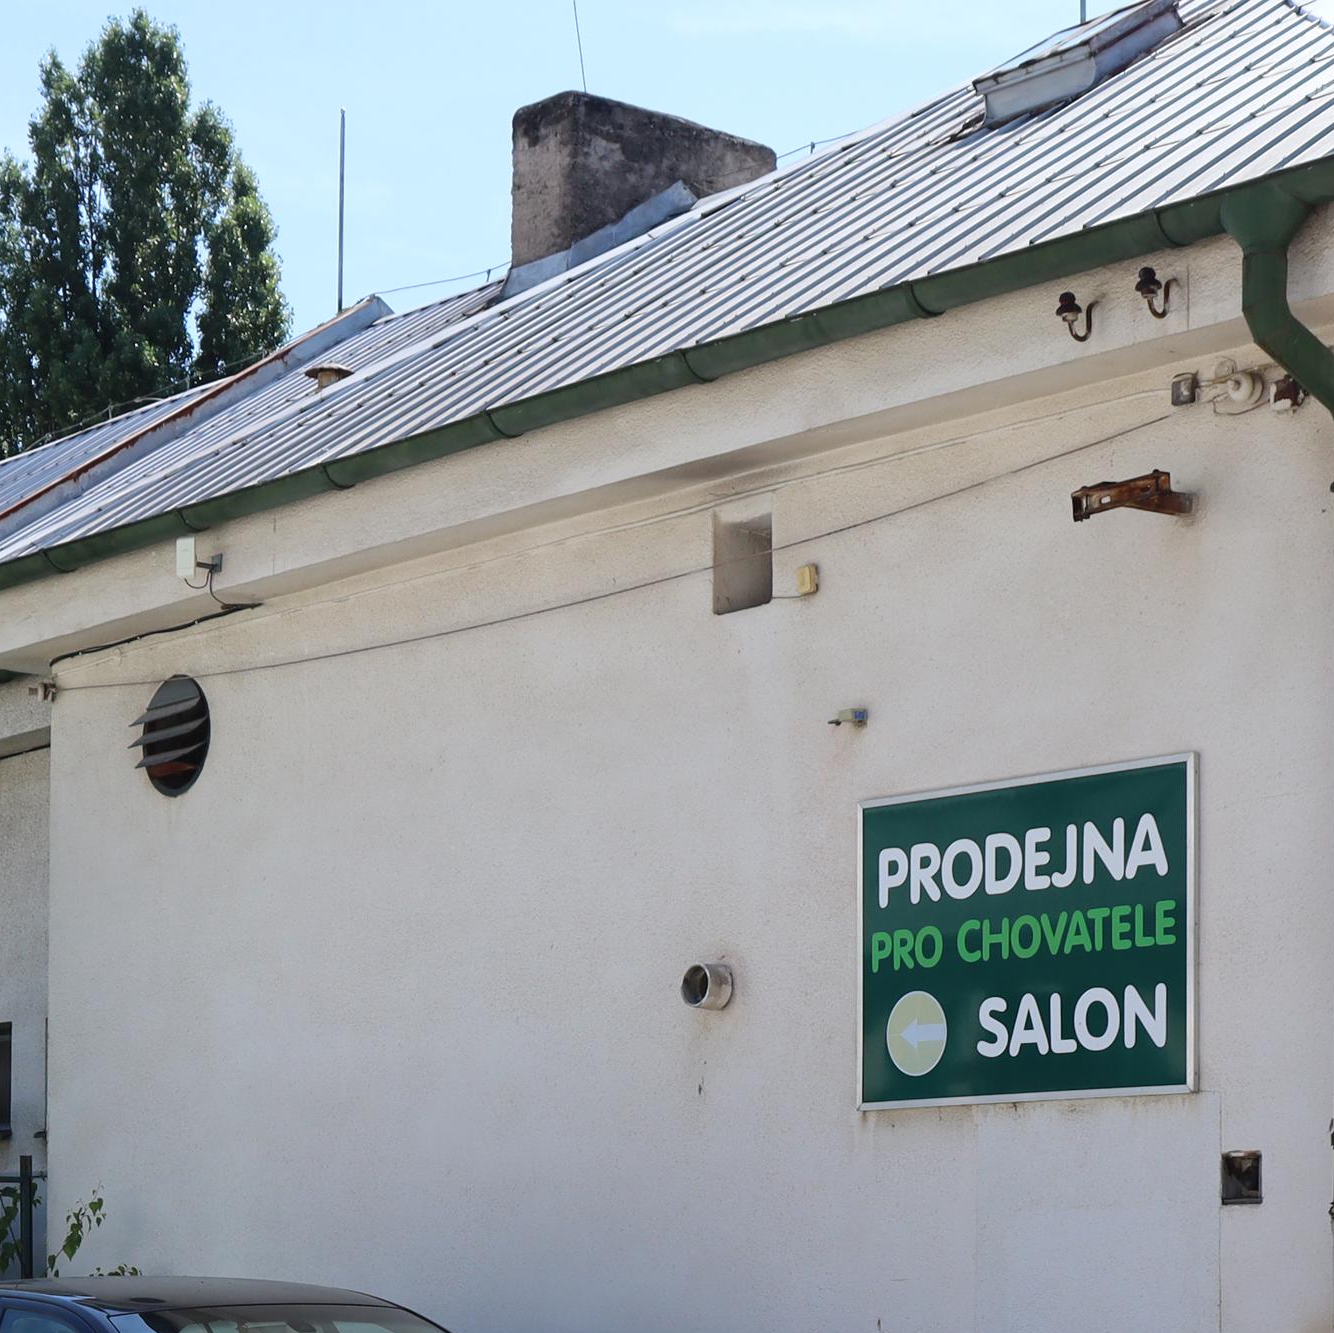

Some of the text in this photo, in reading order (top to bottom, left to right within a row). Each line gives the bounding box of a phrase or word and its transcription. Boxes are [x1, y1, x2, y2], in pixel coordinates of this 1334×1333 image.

[878, 812, 1170, 909] PRODEJNA
[871, 899, 1177, 974] PRO CHOVATELE
[976, 982, 1168, 1059] SALON
